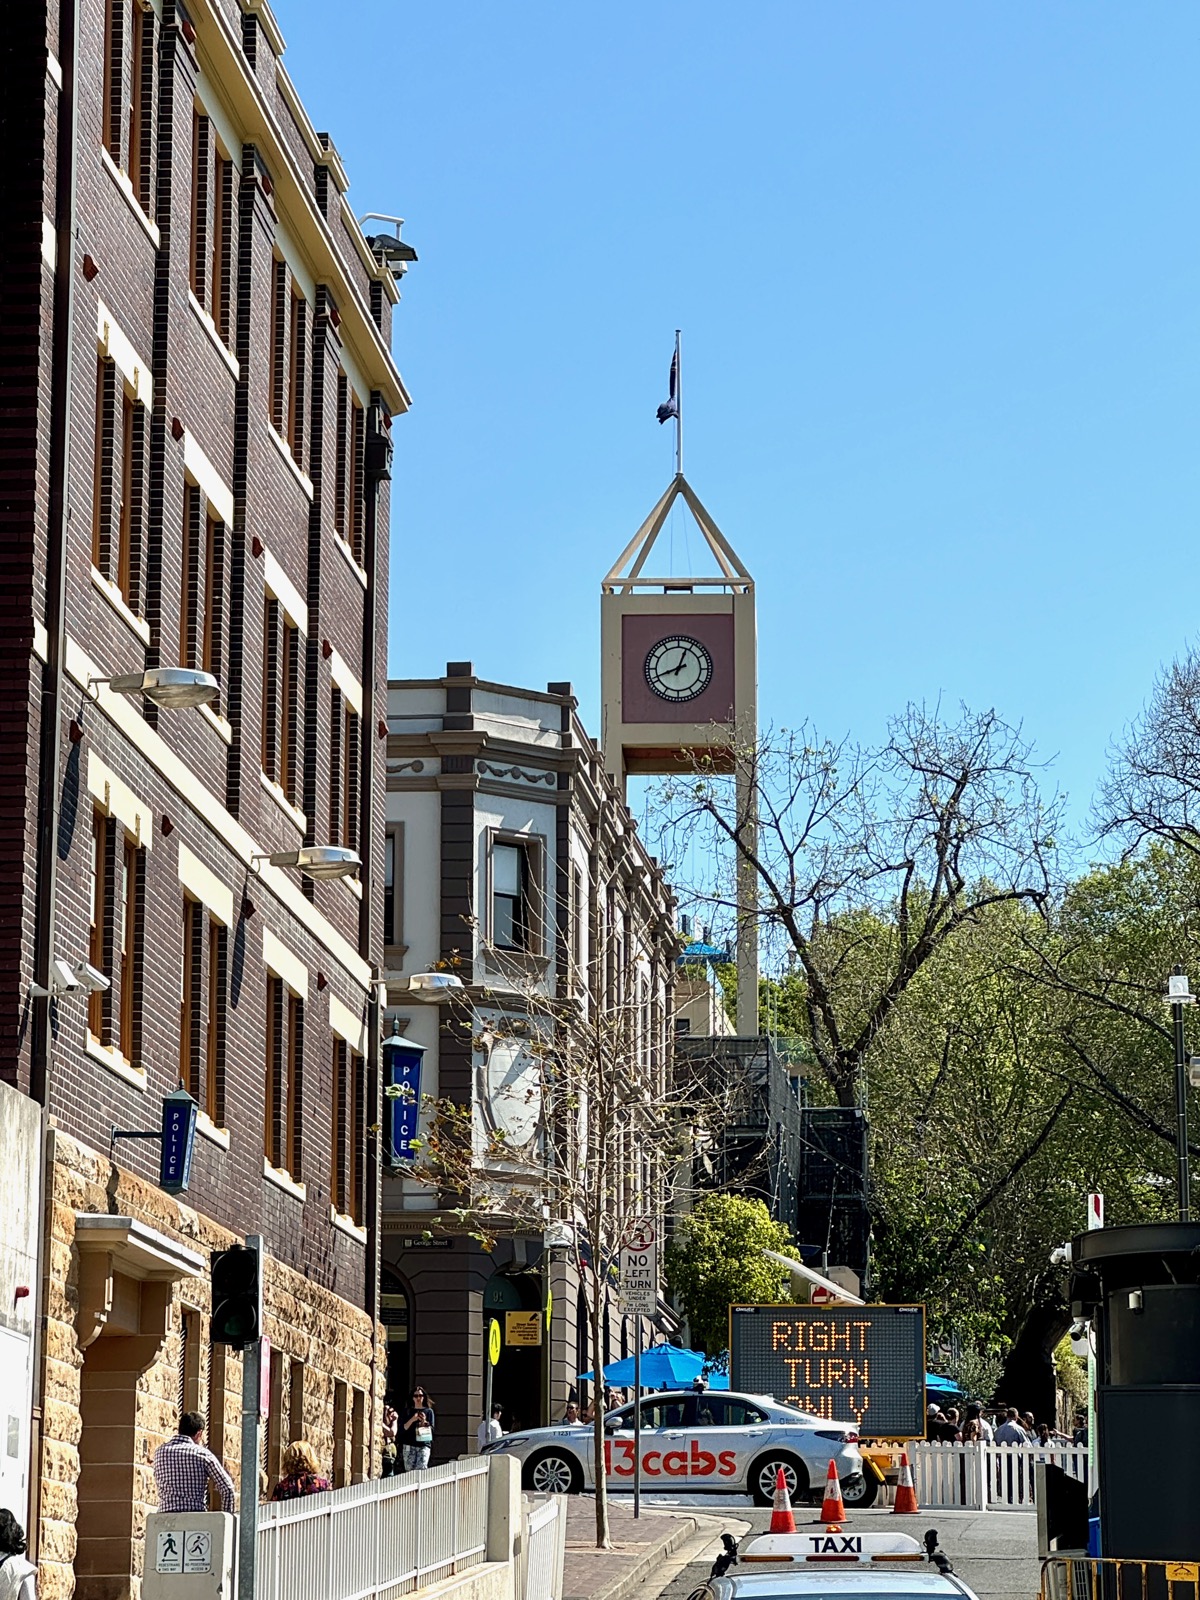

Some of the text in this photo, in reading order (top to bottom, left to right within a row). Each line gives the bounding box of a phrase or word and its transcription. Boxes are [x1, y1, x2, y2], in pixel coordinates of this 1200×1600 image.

[400, 1066, 411, 1150] POLICE
[169, 1112, 180, 1175] POLICE
[625, 1269, 651, 1278] LEFT
[627, 1255, 648, 1267] NO
[624, 1280, 652, 1289] TURN
[772, 1321, 872, 1351] RIGHT
[783, 1358, 869, 1388] TURN
[603, 1440, 737, 1476] 13cabs
[808, 1536, 862, 1553] TAXI
